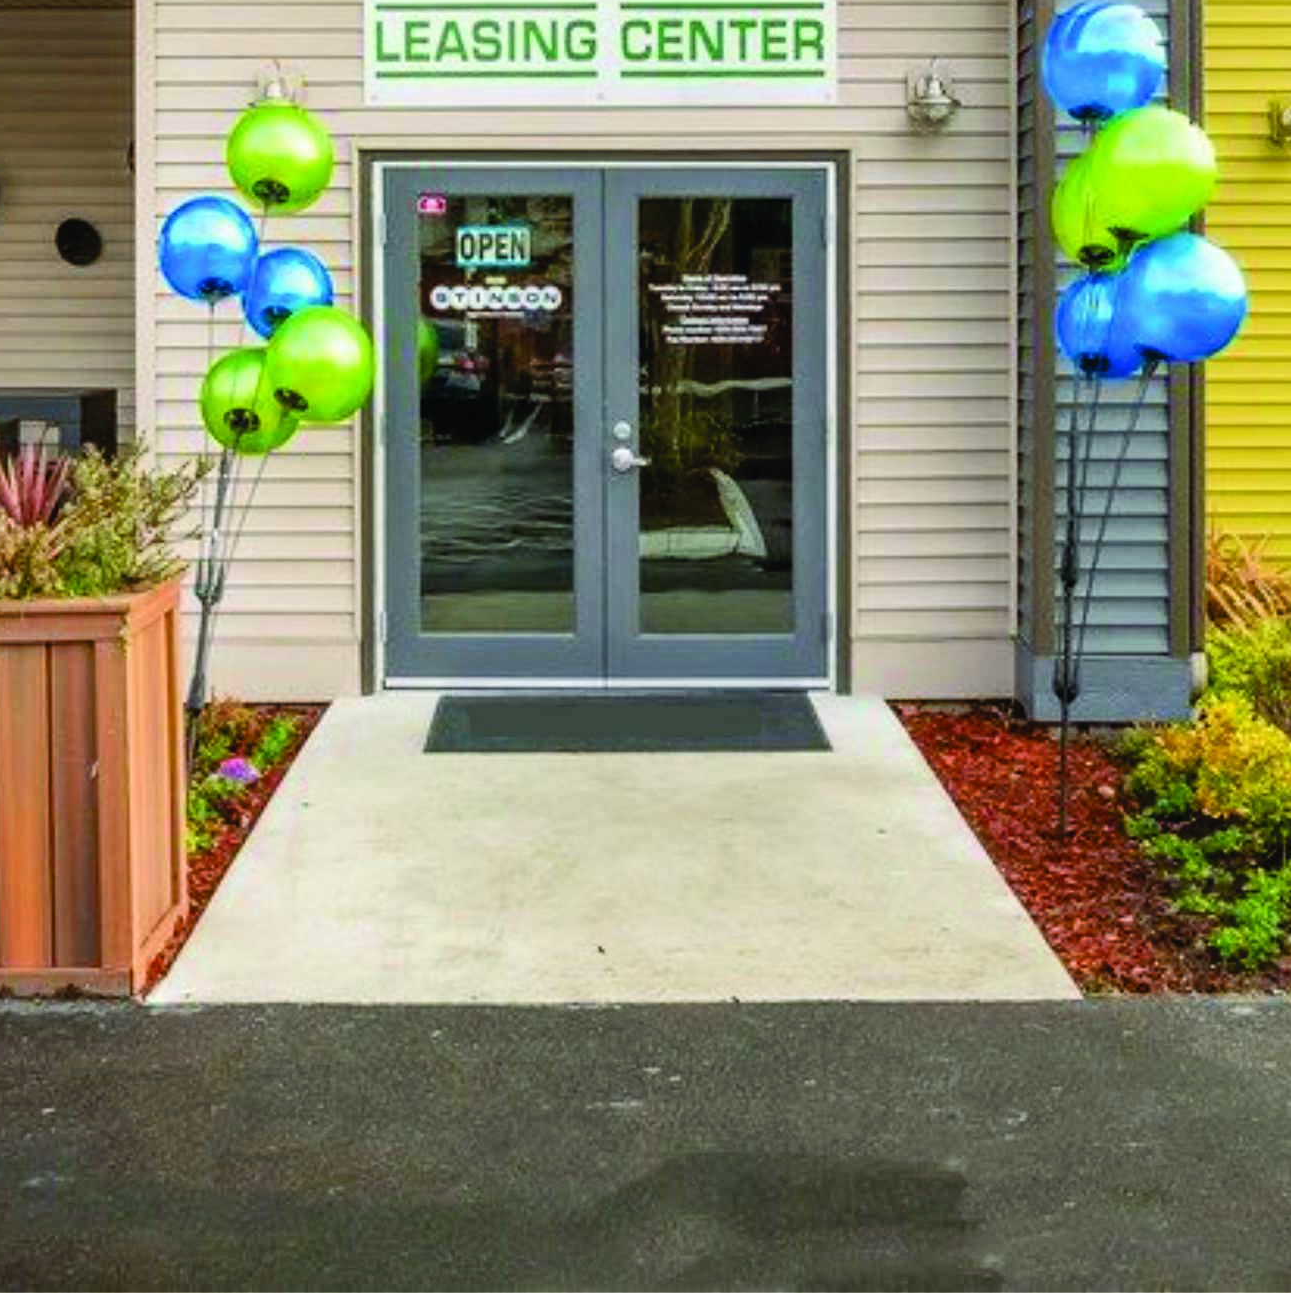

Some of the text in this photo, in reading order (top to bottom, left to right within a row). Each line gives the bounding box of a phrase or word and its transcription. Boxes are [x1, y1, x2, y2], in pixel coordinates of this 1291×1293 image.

[375, 19, 825, 62] LEASING CENTER
[460, 233, 526, 261] OPEN
[434, 290, 560, 306] STINSON
